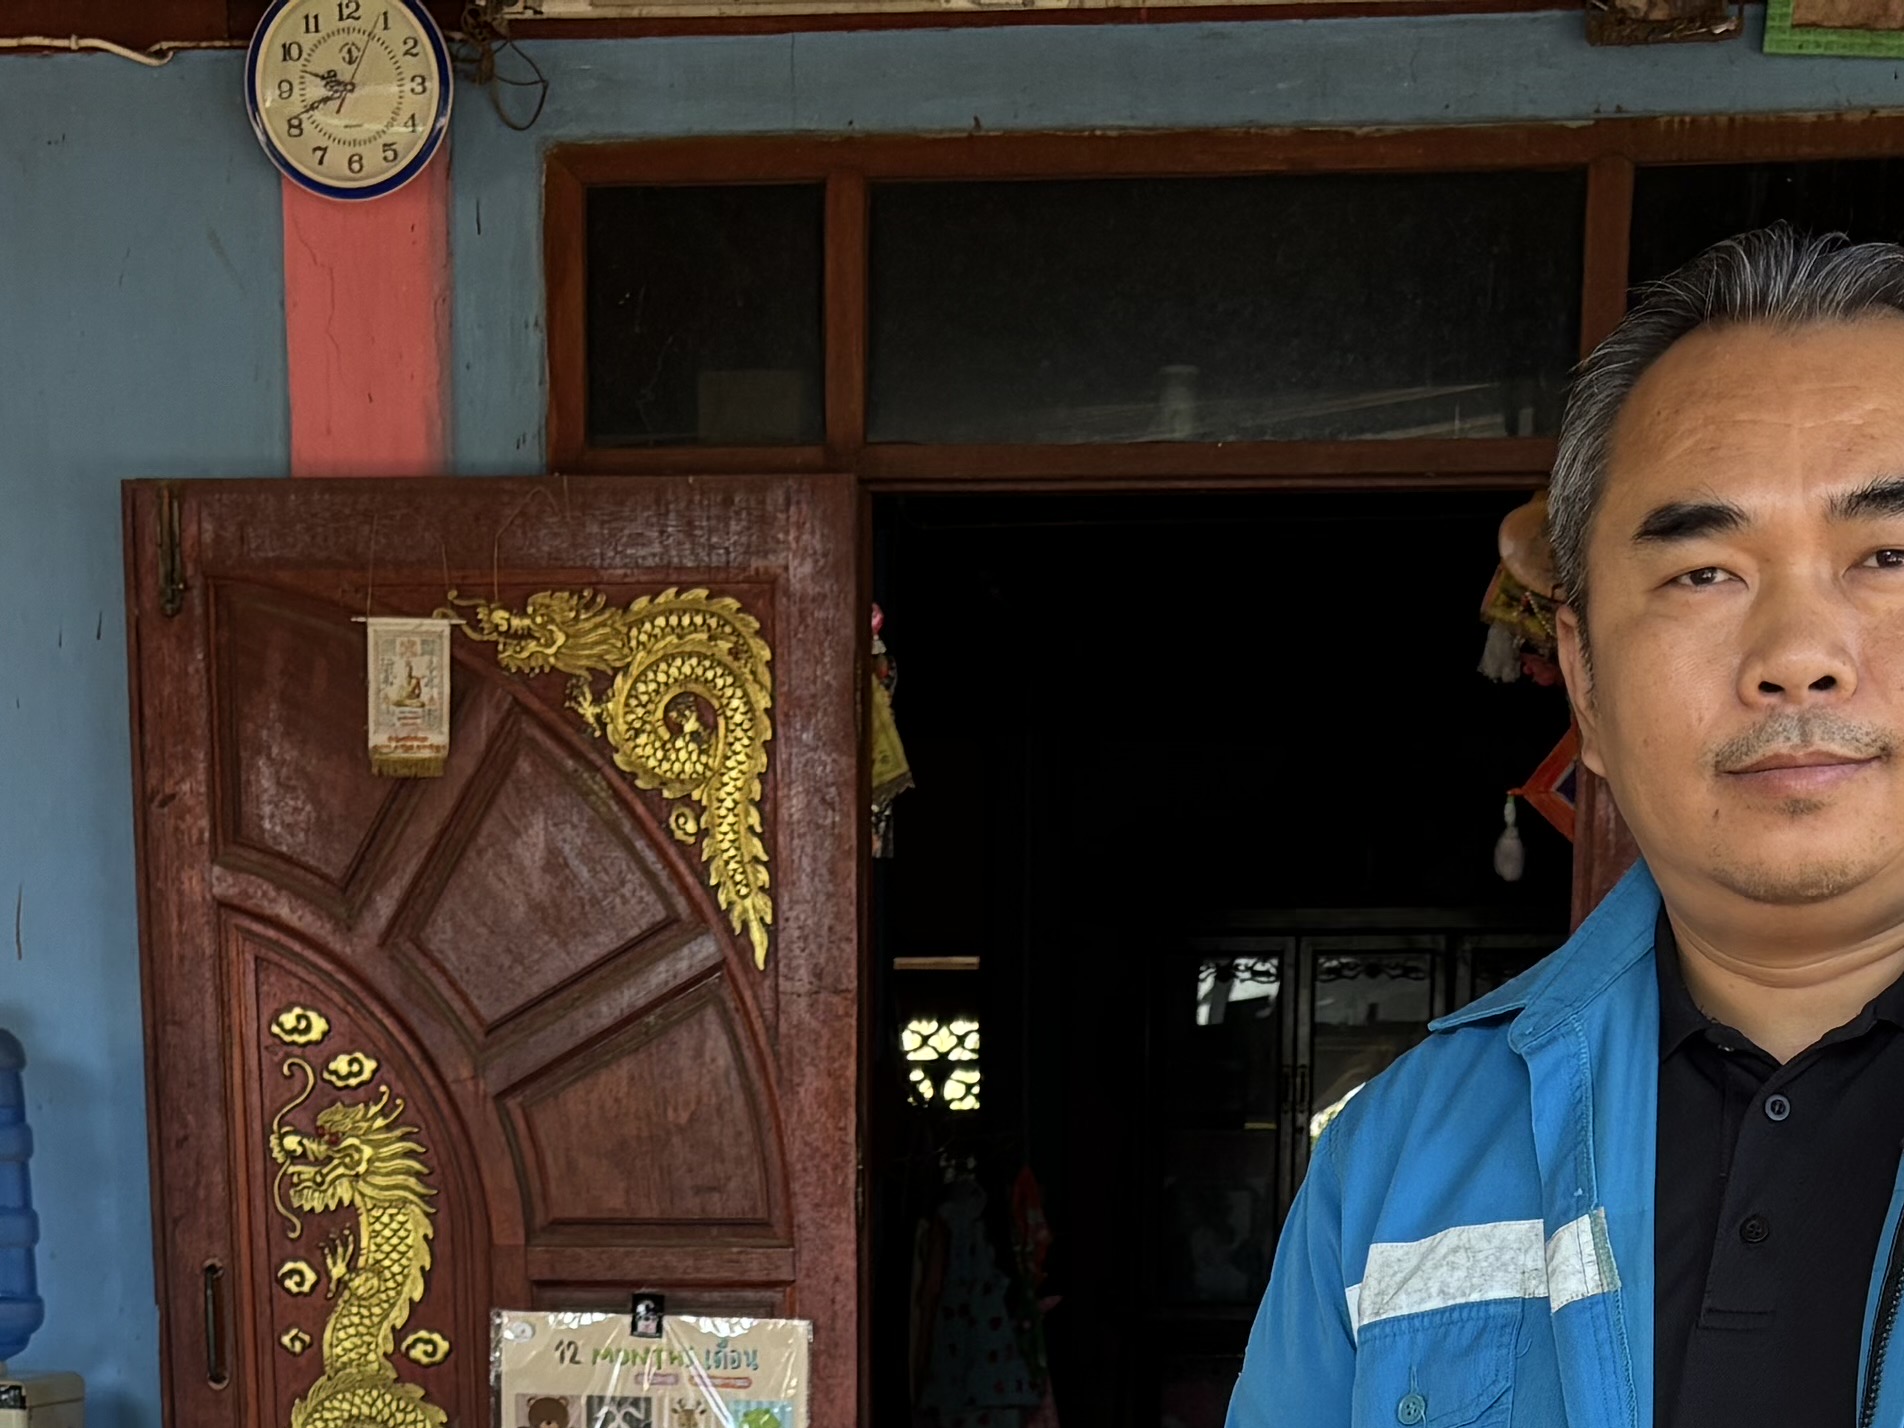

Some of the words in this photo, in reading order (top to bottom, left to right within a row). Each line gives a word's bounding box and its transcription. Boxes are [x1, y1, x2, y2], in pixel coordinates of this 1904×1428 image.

[304, 13, 320, 33] 11
[383, 11, 390, 30] 1
[337, 0, 362, 21] 12
[281, 41, 303, 62] 10
[403, 37, 419, 57] 2
[278, 79, 293, 99] 9
[410, 75, 426, 95] 3
[287, 117, 303, 137] 8
[404, 113, 417, 133] 4
[312, 146, 328, 165] 7
[382, 142, 398, 162] 5
[348, 153, 363, 174] 6
[554, 1340, 582, 1365] 12
[705, 1340, 759, 1370] เดือน
